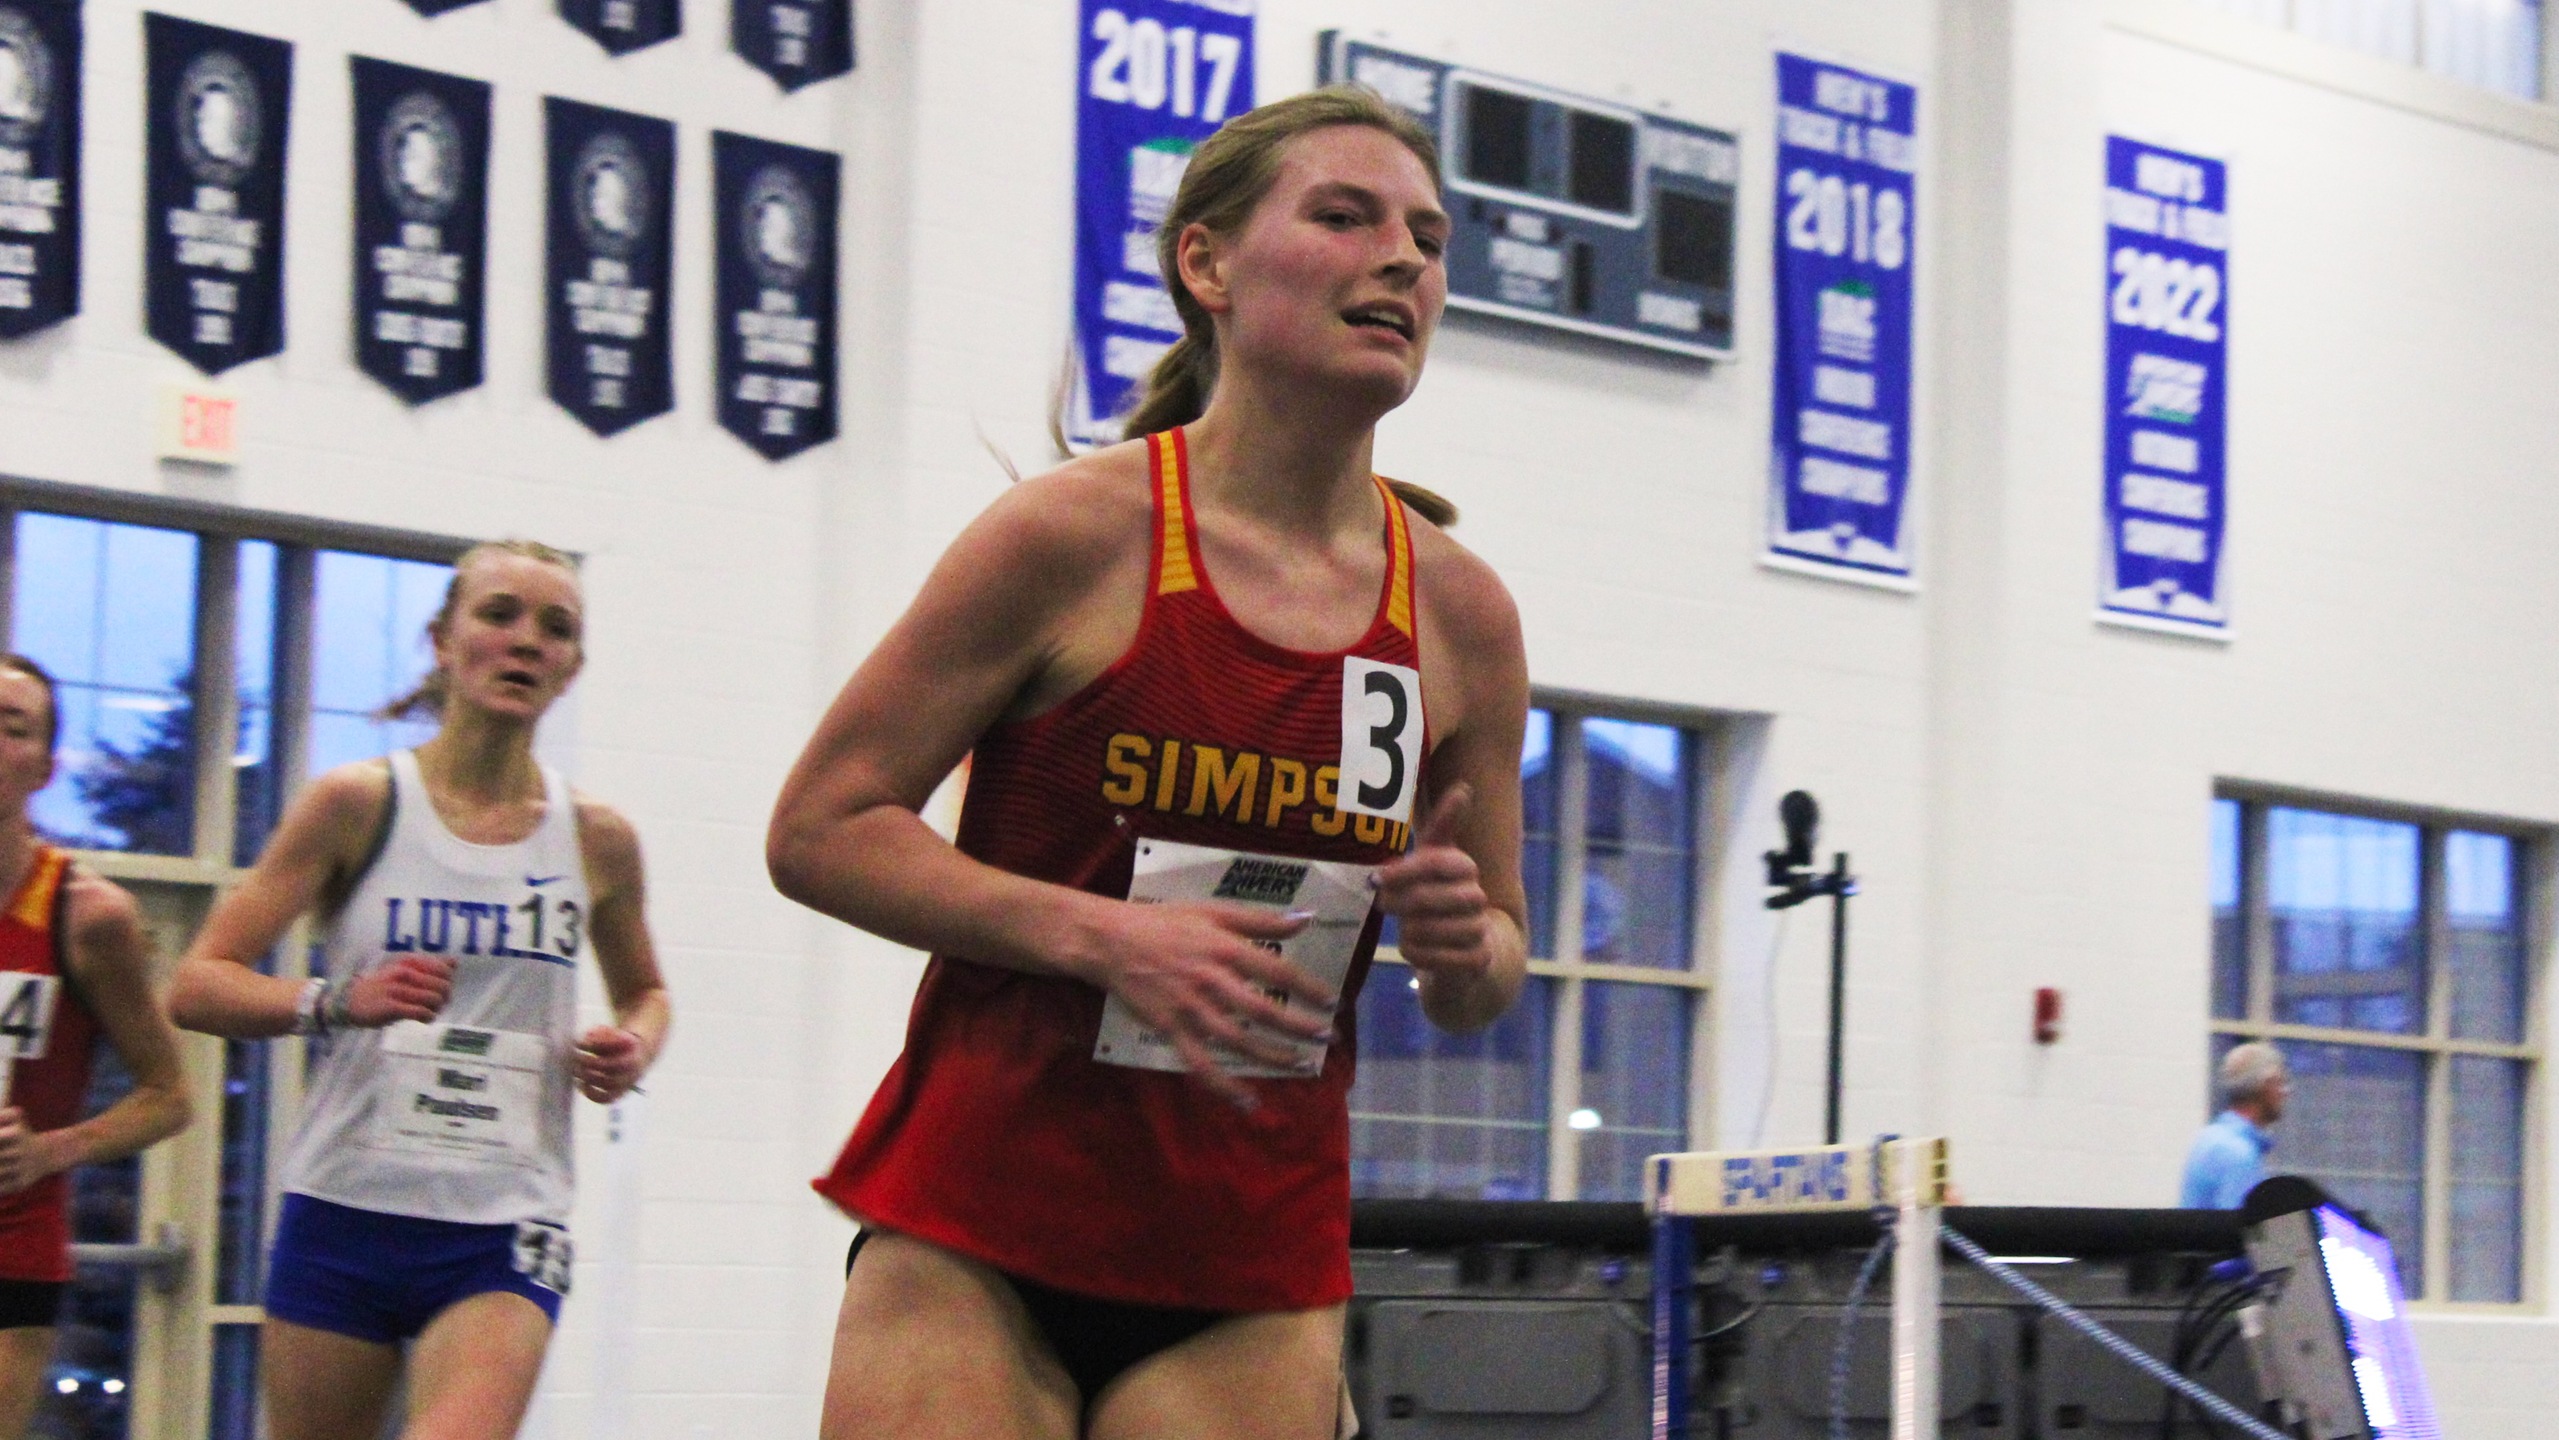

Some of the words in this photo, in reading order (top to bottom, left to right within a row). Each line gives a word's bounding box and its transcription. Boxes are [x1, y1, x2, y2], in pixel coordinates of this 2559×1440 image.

[1089, 8, 1243, 122] 2017
[1786, 168, 1904, 270] 2018
[2113, 246, 2220, 342] 2022
[184, 394, 236, 450] EXIT
[1358, 671, 1408, 811] 3
[1230, 857, 1309, 881] AMERICAN
[518, 893, 583, 957] 13
